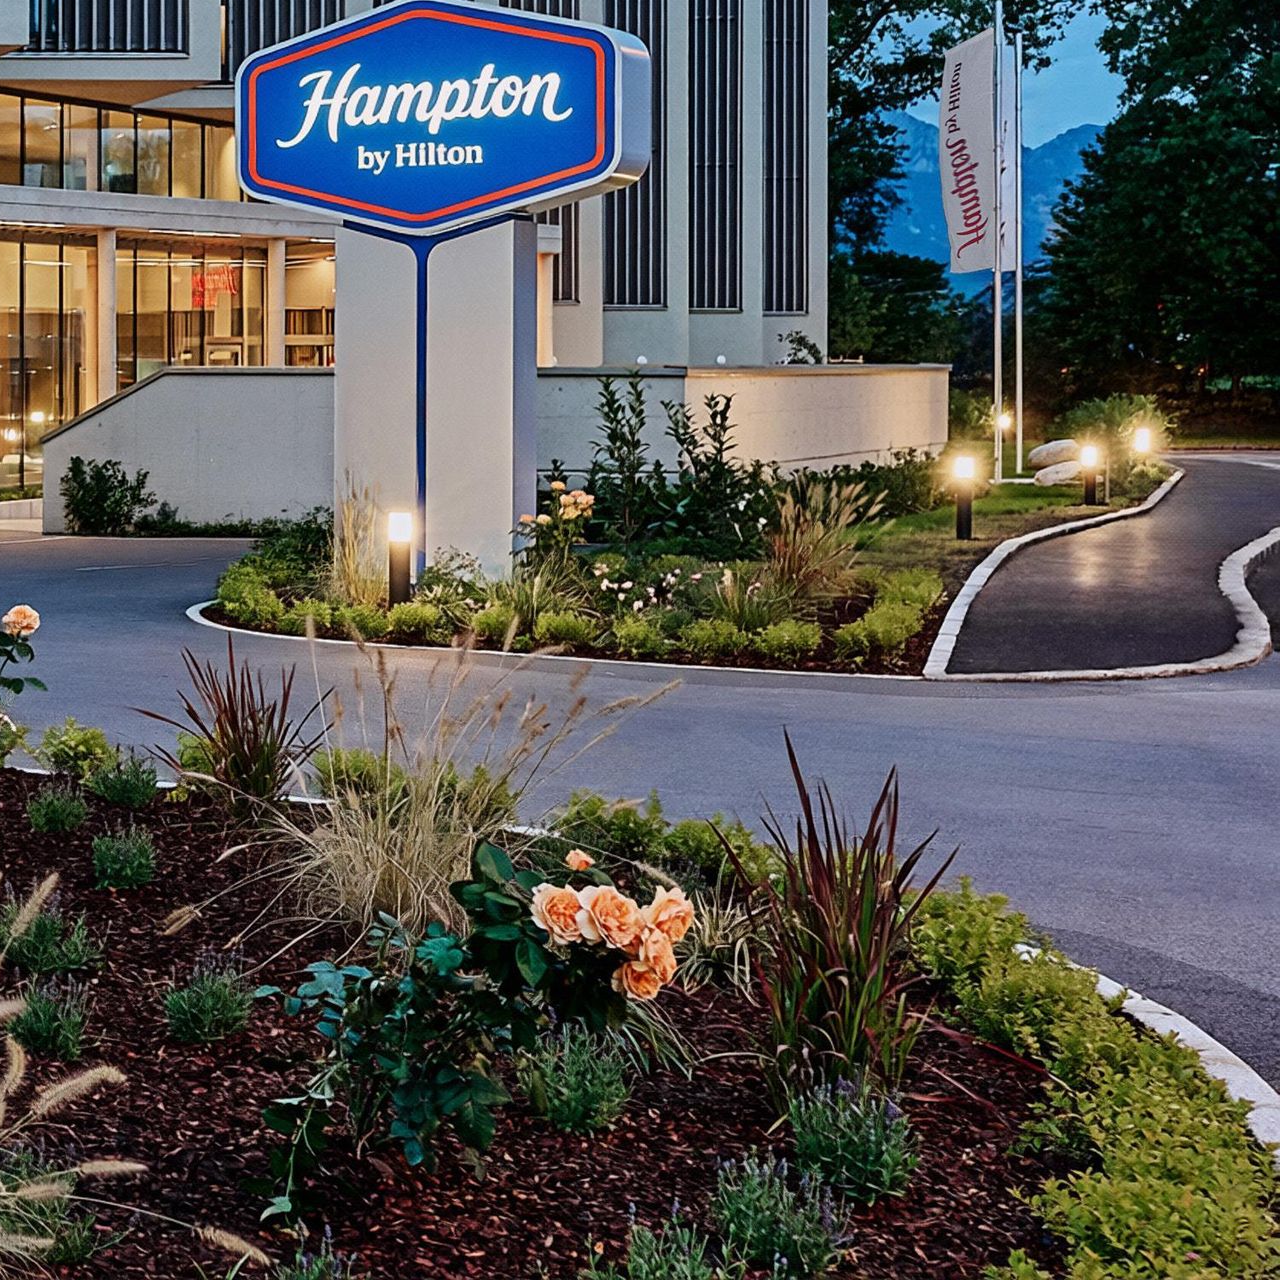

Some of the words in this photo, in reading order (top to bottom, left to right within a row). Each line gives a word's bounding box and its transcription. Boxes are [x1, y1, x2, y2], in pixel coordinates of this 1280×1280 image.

[276, 64, 573, 148] Hampton
[357, 145, 390, 175] by
[396, 142, 483, 168] Hilton
